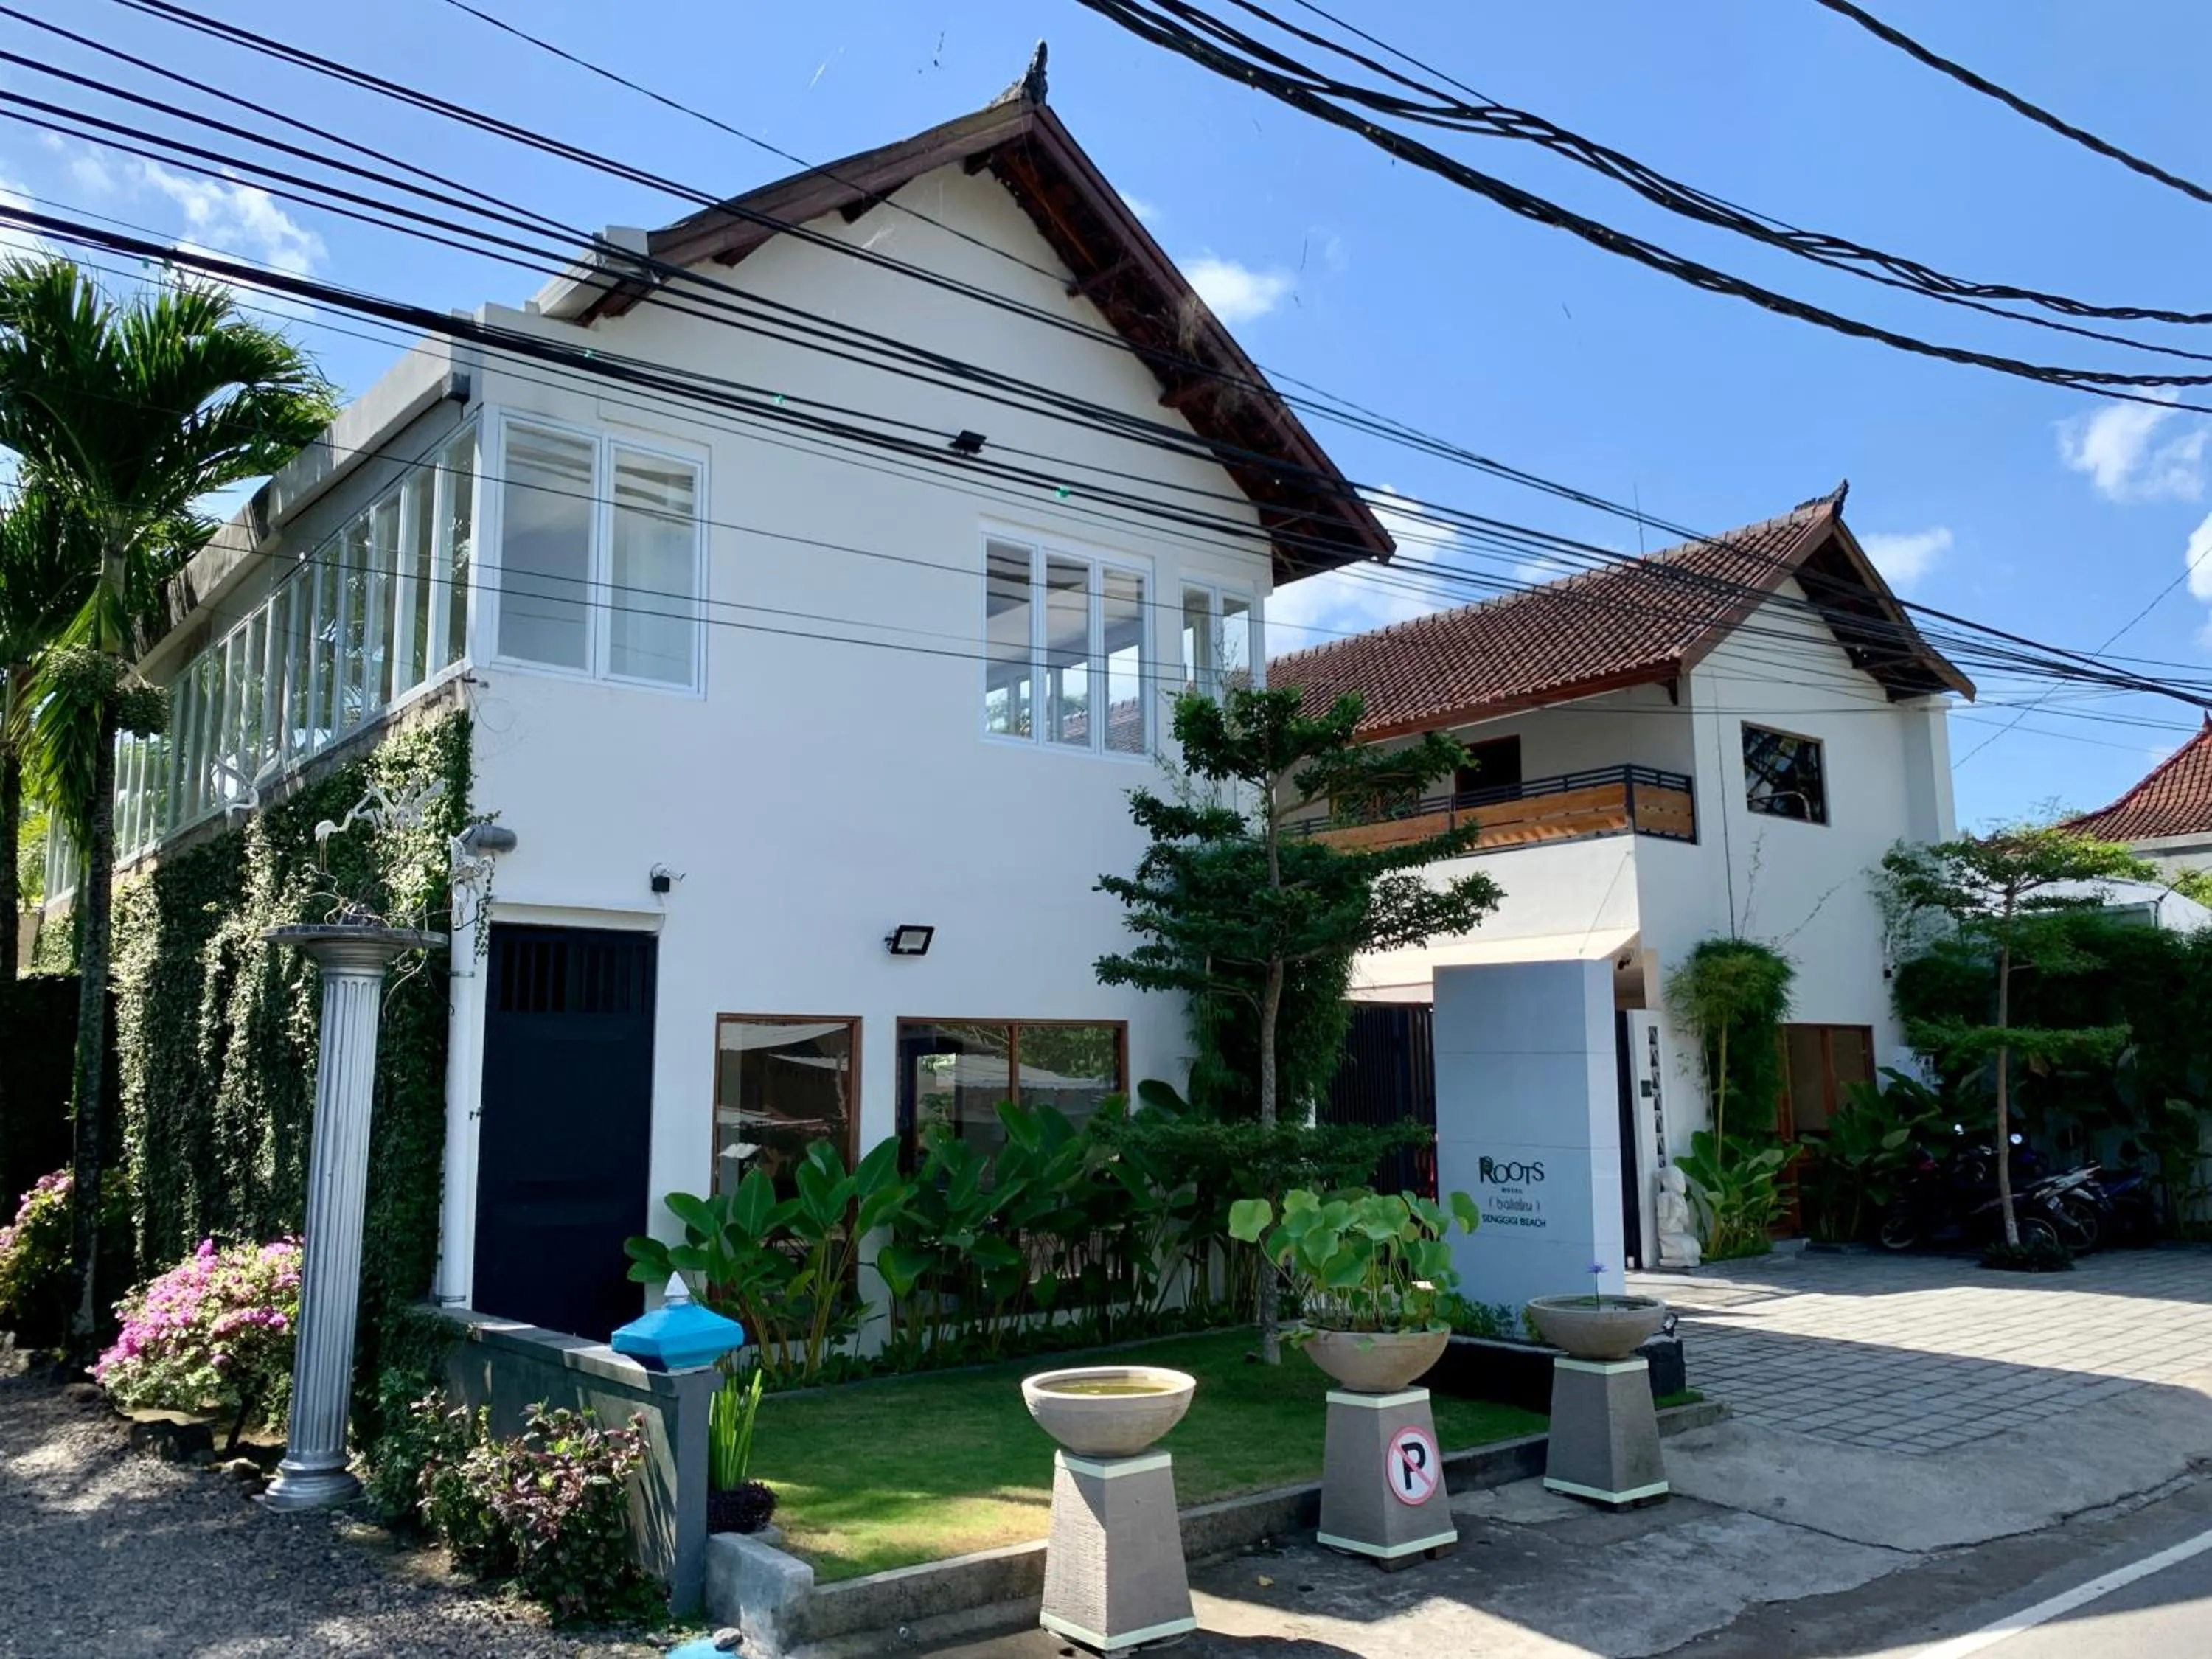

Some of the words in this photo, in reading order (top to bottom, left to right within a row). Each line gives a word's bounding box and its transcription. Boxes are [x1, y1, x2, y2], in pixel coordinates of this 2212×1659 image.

[1479, 1155, 1545, 1185] ROOTS
[1520, 1217, 1546, 1228] BEACH
[1401, 1442, 1425, 1490] P
